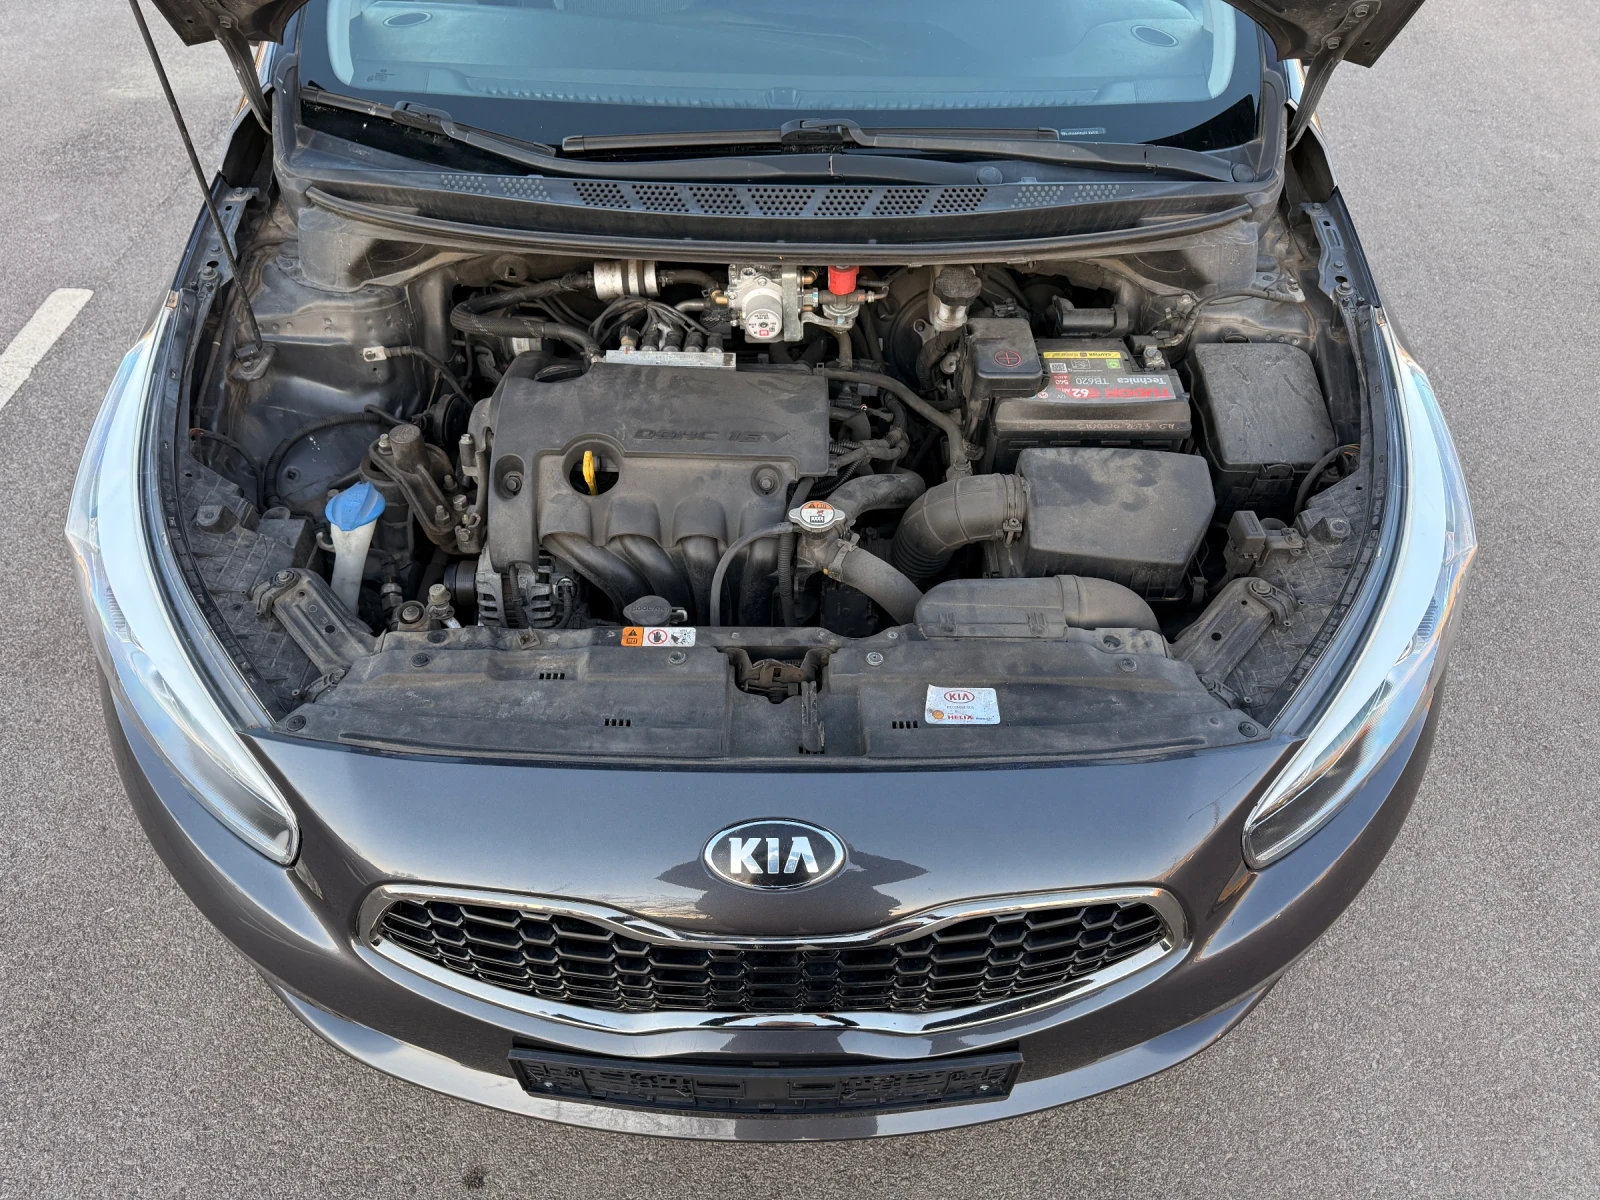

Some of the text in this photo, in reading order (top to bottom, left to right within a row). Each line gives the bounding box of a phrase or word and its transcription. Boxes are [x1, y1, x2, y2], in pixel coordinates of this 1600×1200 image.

[1075, 377, 1109, 385] TB620
[1117, 377, 1167, 385] Technica
[1072, 388, 1090, 398] 62
[1105, 387, 1172, 398] TUDOR
[728, 430, 790, 443] 16V
[949, 693, 970, 701] KIA
[728, 836, 820, 874] KIA
